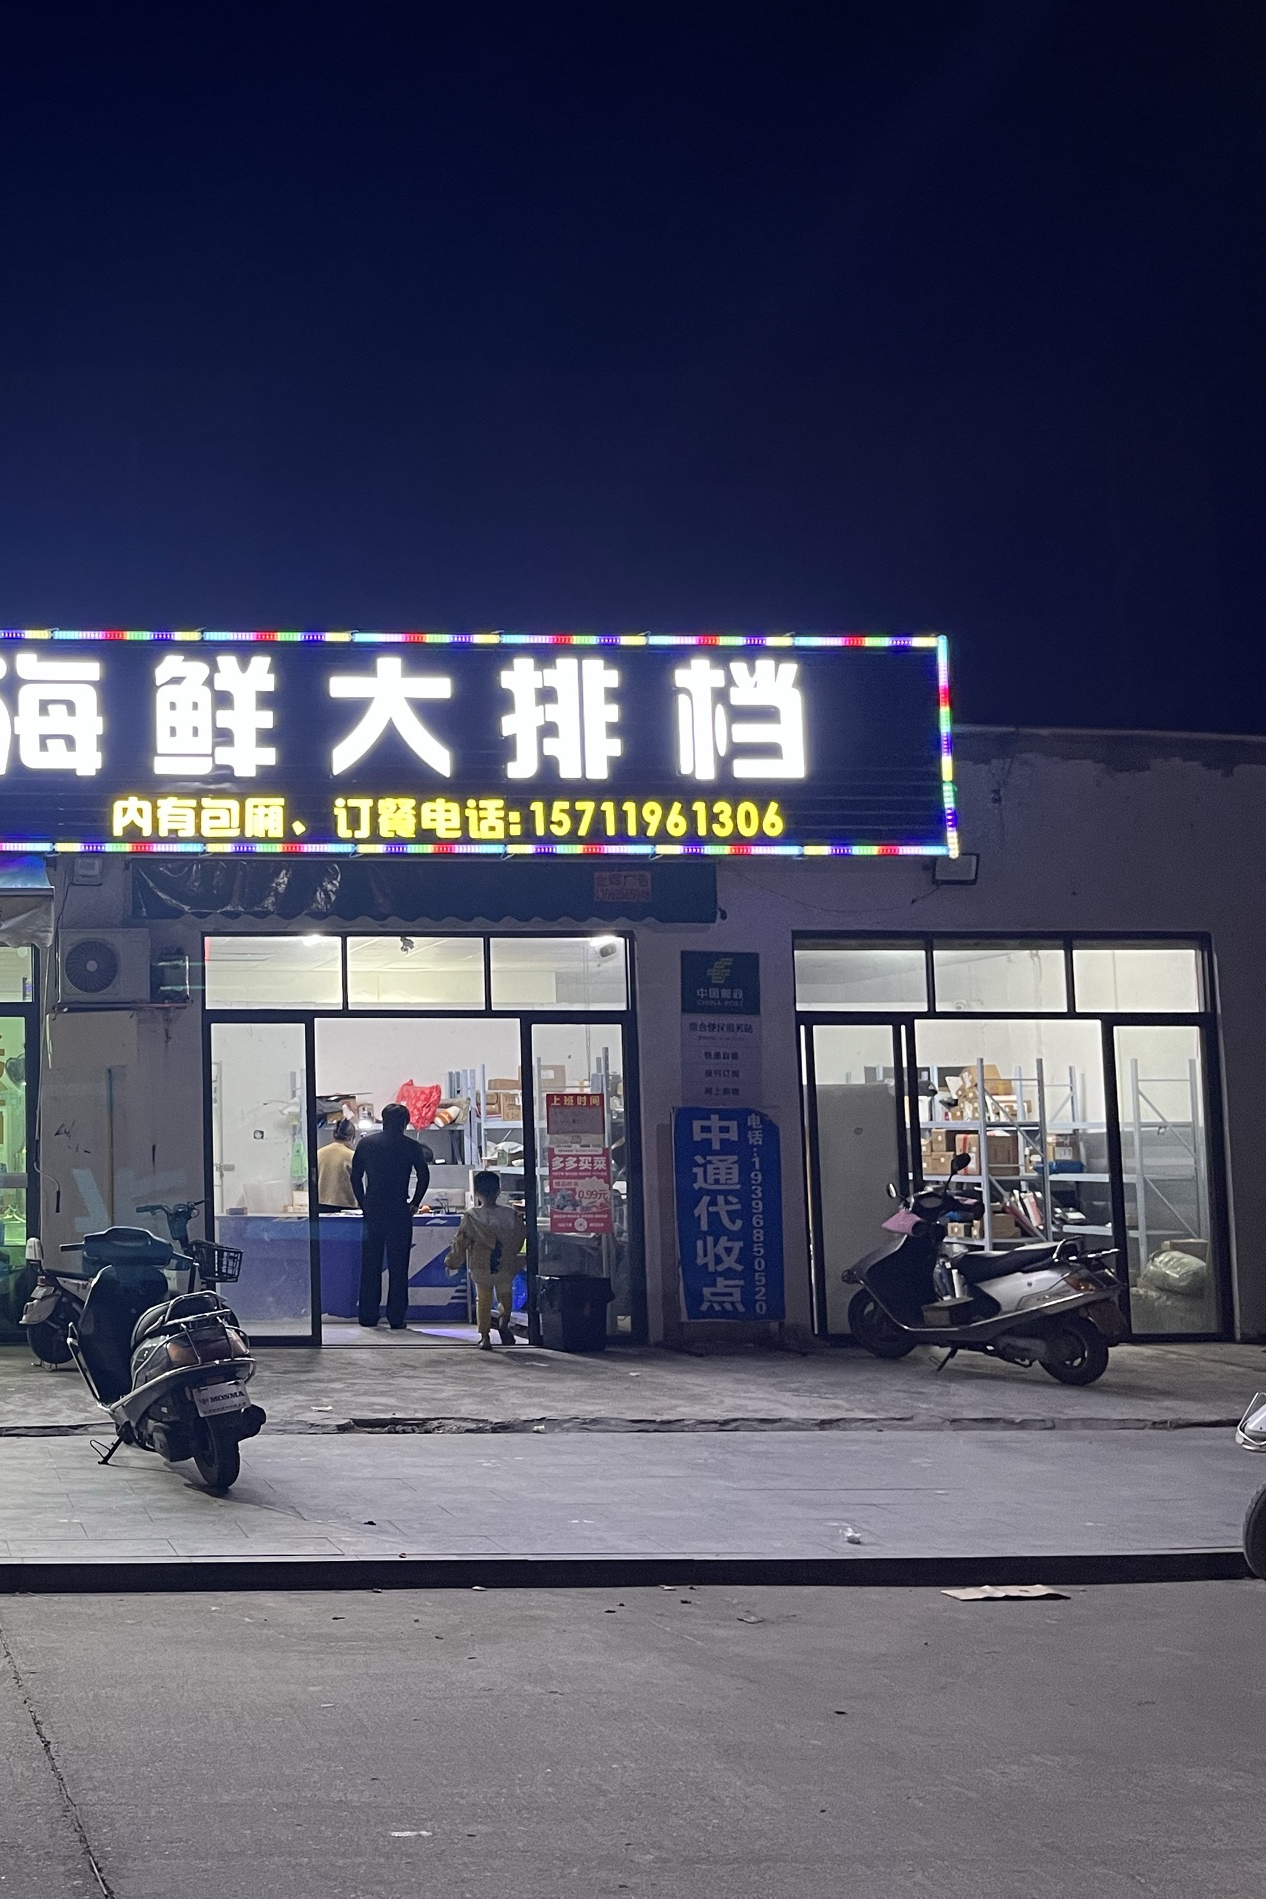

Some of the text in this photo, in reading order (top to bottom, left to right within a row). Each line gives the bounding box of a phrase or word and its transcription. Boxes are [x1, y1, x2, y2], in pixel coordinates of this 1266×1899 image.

[696, 987, 744, 999] 中国邮政
[696, 999, 744, 1007] CHINA POST
[550, 1095, 601, 1106] 上班时间
[551, 1156, 607, 1171] 多多买菜
[578, 1189, 609, 1200] 0.99元
[691, 1113, 747, 1313] 中通代收点
